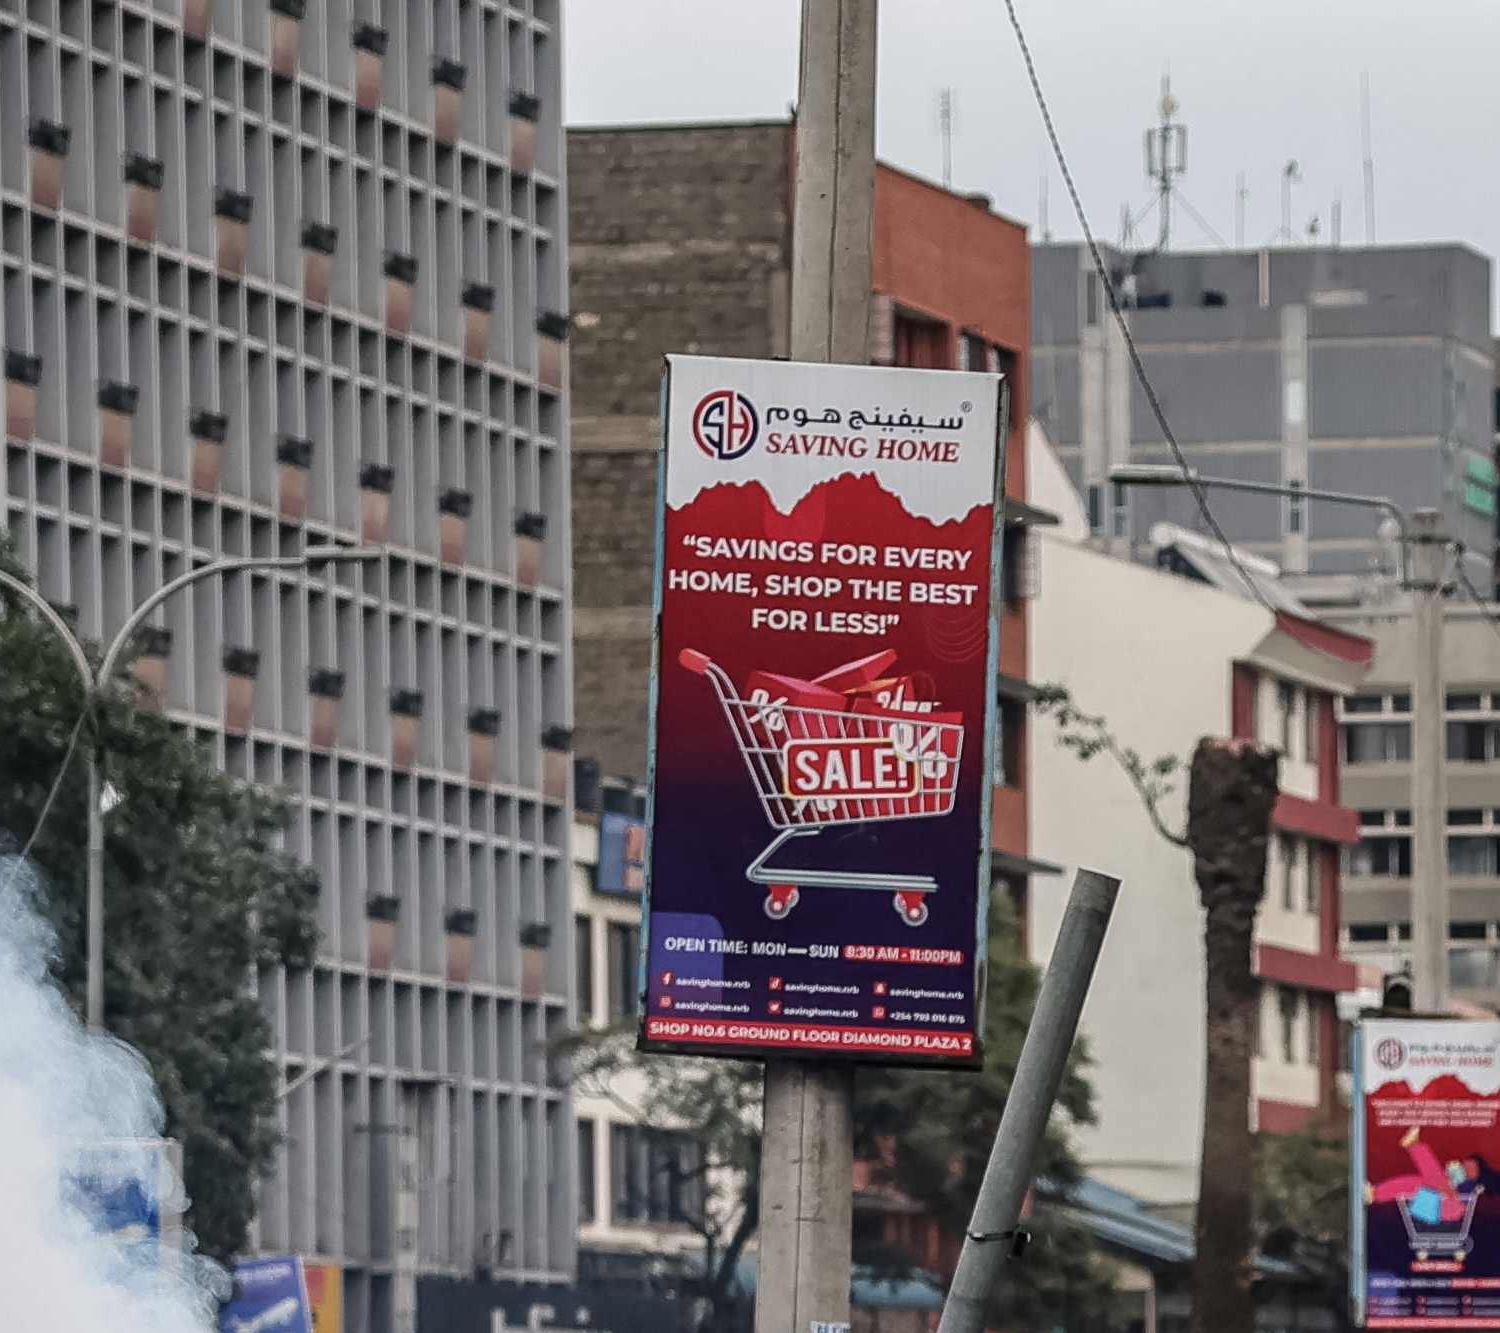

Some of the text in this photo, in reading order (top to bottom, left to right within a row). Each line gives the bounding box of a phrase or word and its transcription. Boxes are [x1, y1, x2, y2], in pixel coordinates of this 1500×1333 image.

[766, 405, 964, 434] سيفينج هوم
[766, 433, 960, 463] SAVING HOME
[820, 543, 877, 566] FOR
[884, 546, 972, 571] EVERY
[668, 569, 978, 605] HOME, SHOP THE BEST
[752, 607, 808, 631] FOR
[795, 748, 909, 791] SALE!
[664, 936, 706, 953] OPEN
[708, 938, 748, 955] TIME:
[877, 948, 900, 961] AM
[649, 1022, 690, 1036] SHOP
[727, 1026, 790, 1041] GROUND
[792, 1029, 840, 1043] FLOOR
[842, 1031, 911, 1047] DIAMOND
[913, 1034, 960, 1050] PLAZA
[961, 1037, 972, 1050] 2
